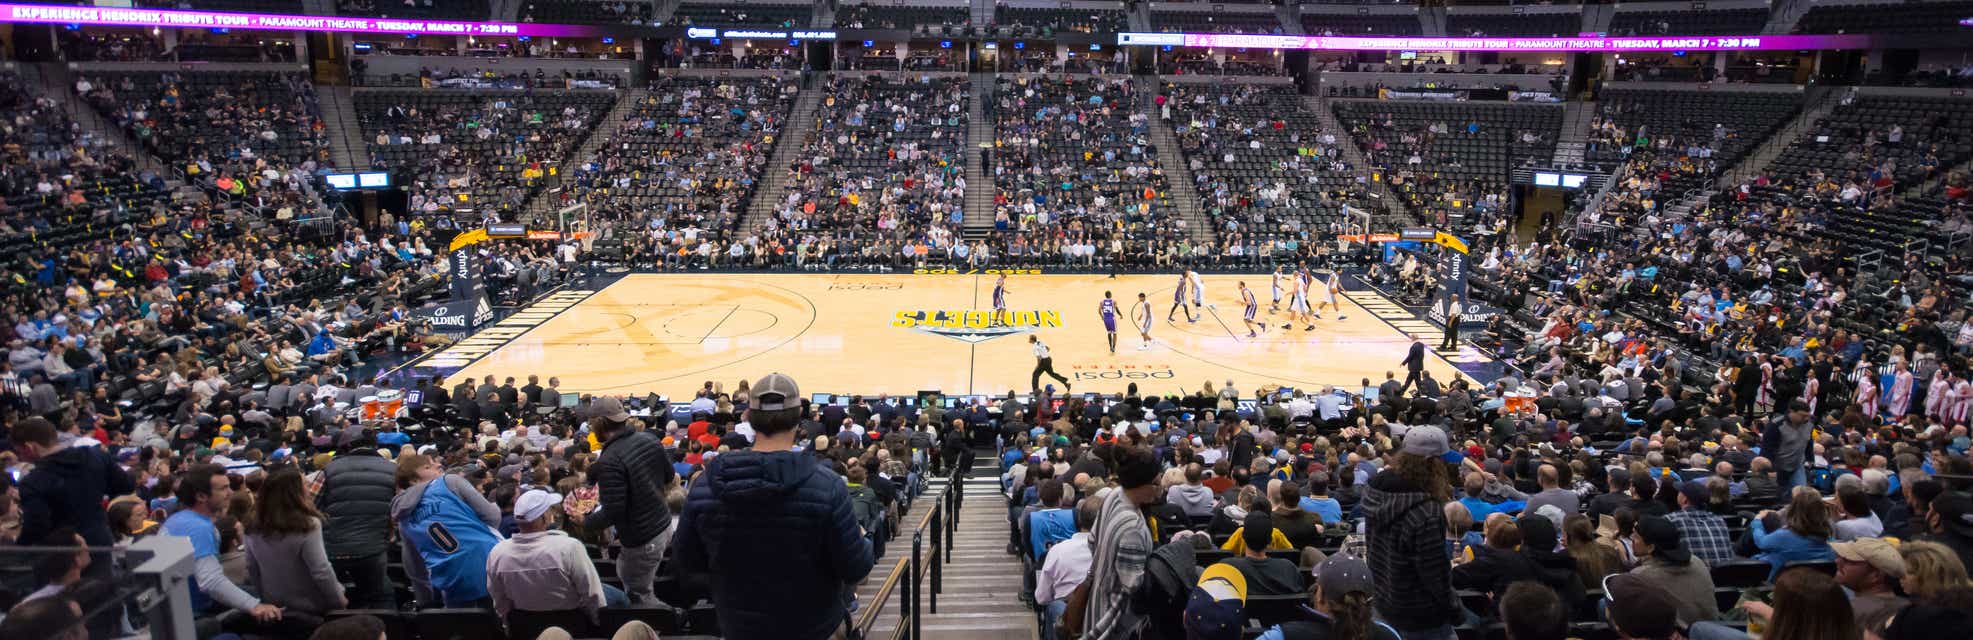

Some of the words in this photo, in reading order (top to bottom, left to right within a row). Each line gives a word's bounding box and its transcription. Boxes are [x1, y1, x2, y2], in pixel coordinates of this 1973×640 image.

[12, 7, 99, 21] EXPERIENCE
[101, 9, 161, 24] HENDRIX
[164, 12, 214, 26] TRIBUTE
[216, 15, 249, 26] TOUR
[259, 16, 325, 29] PARAMOUNT
[326, 19, 368, 30] THEATRE
[376, 22, 426, 33] TUESDAY,
[427, 22, 465, 33] MARCH
[466, 24, 472, 33] 7
[501, 24, 518, 34] PM
[1485, 40, 1509, 49] TOUR
[1515, 39, 1566, 49] PARAMOUNT
[1568, 40, 1604, 49] THEATRE
[1612, 39, 1660, 49] TUESDAY,
[1661, 39, 1700, 48] MARCH
[1702, 39, 1708, 48] 7
[1717, 38, 1739, 48] 7:30
[1741, 38, 1760, 47] PM
[457, 249, 468, 279] xfinity
[1451, 252, 1462, 281] xfinity
[891, 309, 1063, 328] NUGGETS
[1103, 305, 1113, 314] 24
[1074, 370, 1175, 382] pepsi
[408, 393, 419, 403] 10
[427, 521, 459, 554] 0
